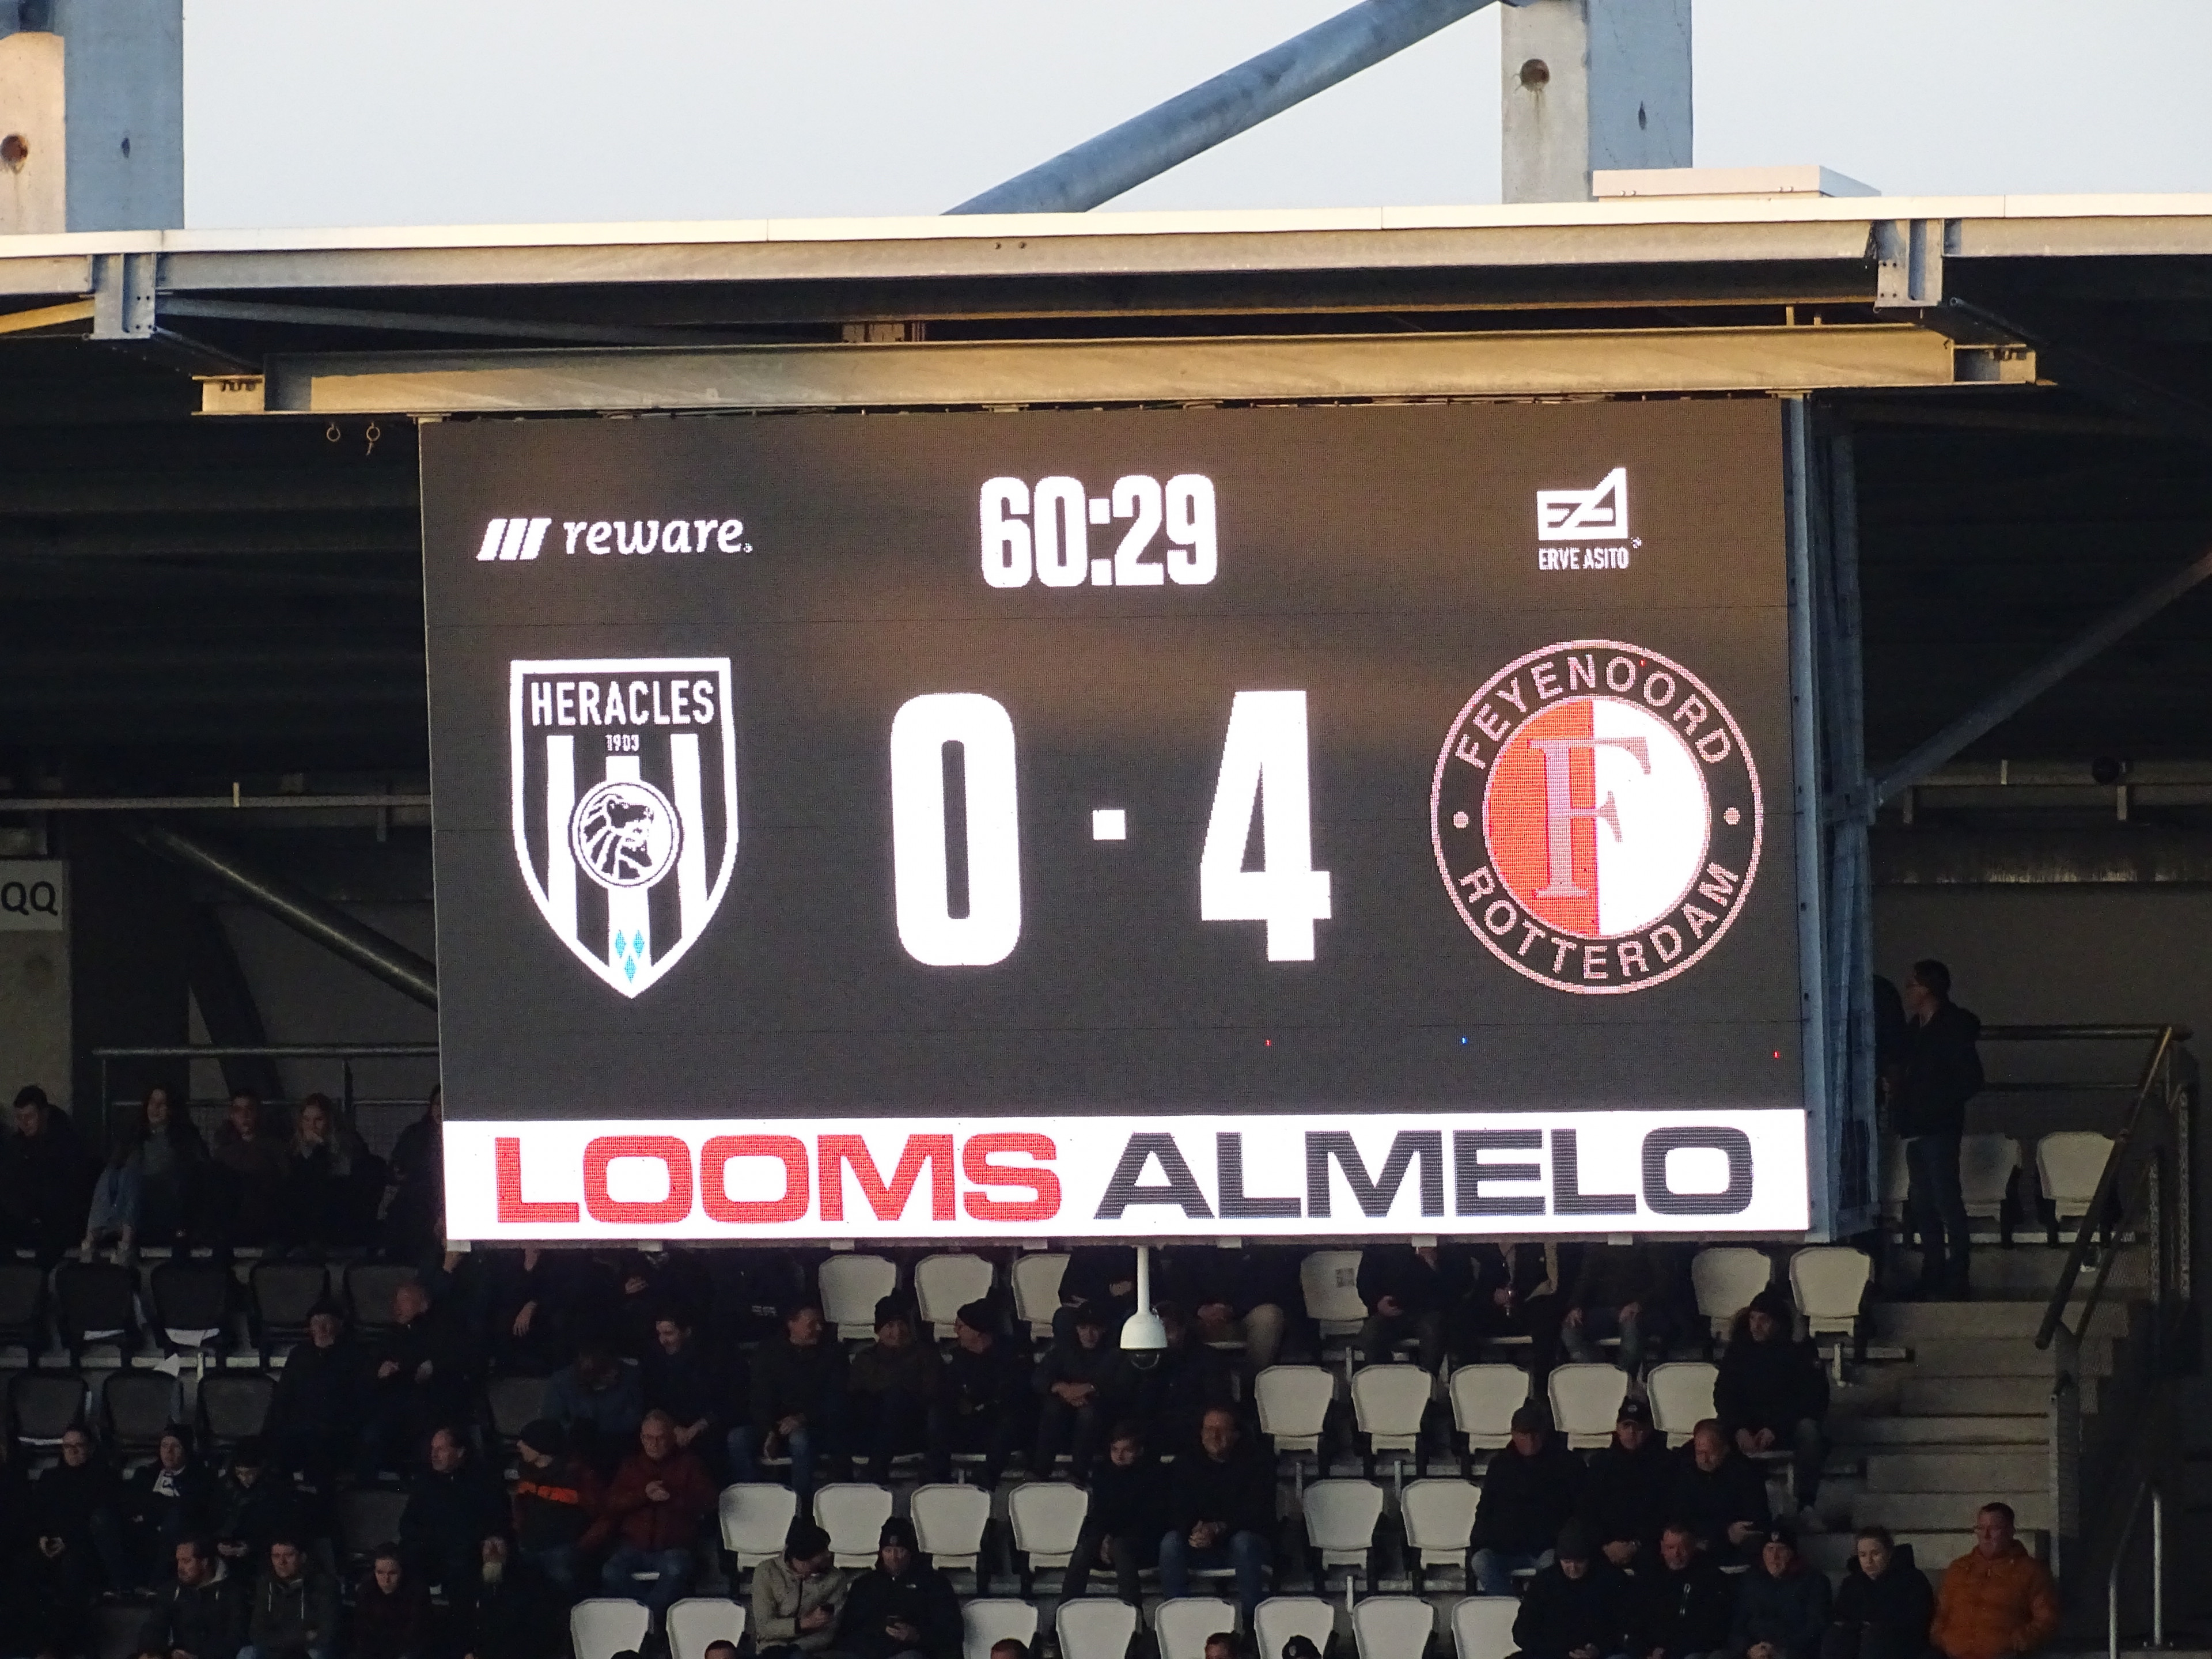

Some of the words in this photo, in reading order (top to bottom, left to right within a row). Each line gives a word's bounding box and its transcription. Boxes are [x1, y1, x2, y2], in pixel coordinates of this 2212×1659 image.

[563, 518, 743, 554] reware
[980, 474, 1217, 588] 60:29
[1538, 547, 1580, 570] ERVE
[1582, 547, 1630, 570] ASITO
[531, 680, 714, 726] HERACLES
[605, 733, 640, 752] 1903
[1455, 654, 1732, 770] FEYENOORD
[890, 692, 1021, 967] 0
[1200, 690, 1332, 962] 4
[1527, 736, 1652, 899] F
[1, 881, 58, 916] QQ
[1459, 862, 1740, 979] ROTTERDAM
[494, 1132, 1062, 1224] LOOMS
[1093, 1126, 1753, 1219] ALMELO
